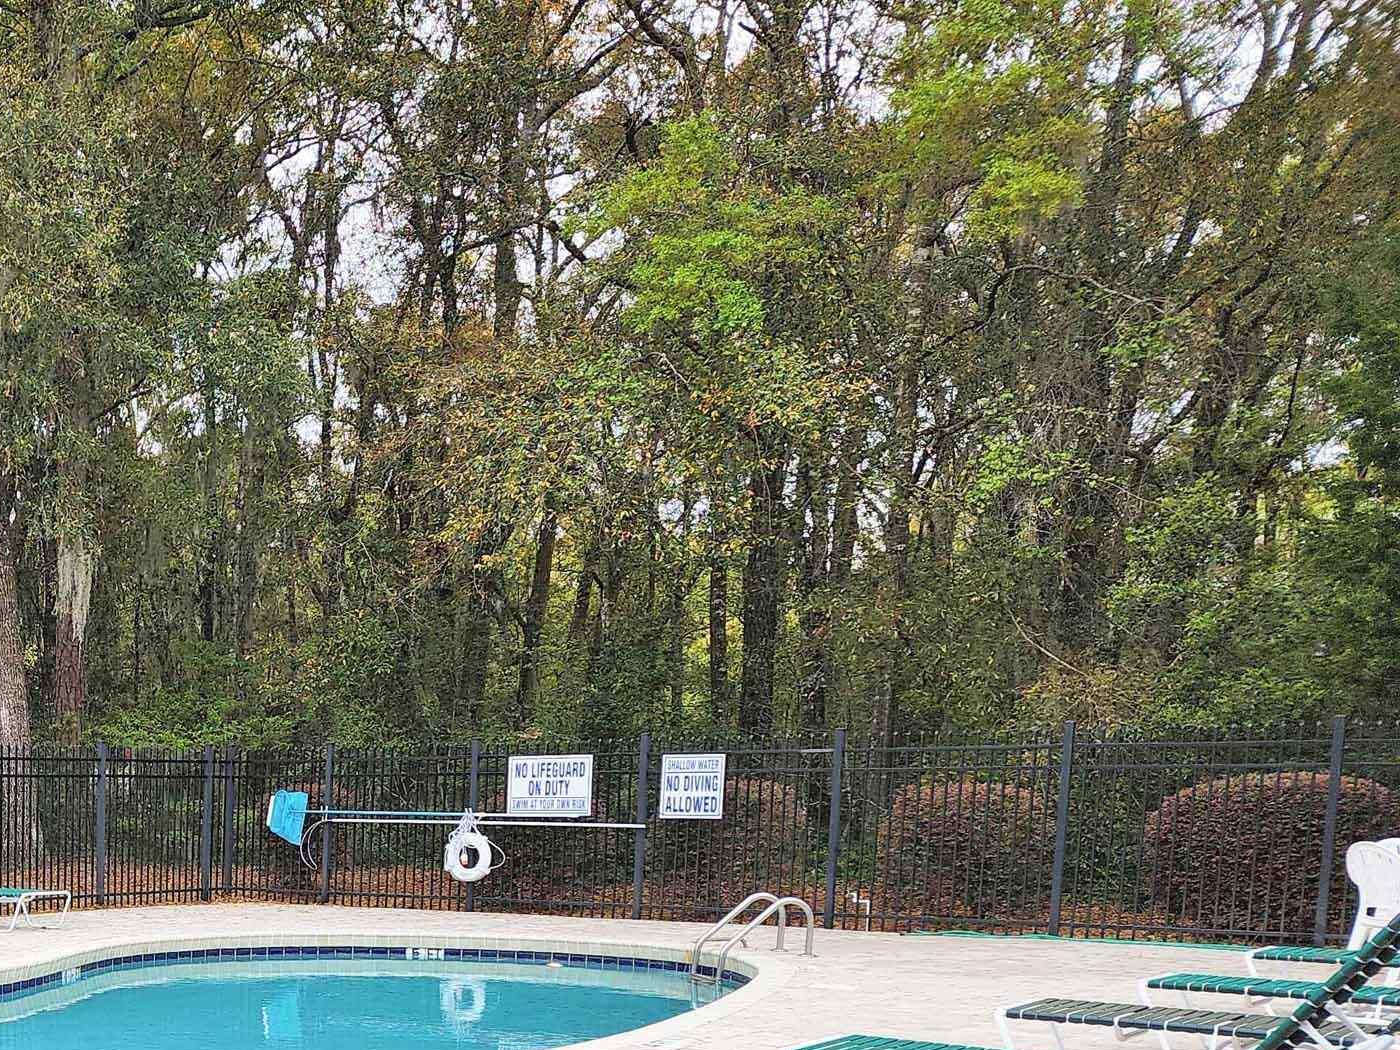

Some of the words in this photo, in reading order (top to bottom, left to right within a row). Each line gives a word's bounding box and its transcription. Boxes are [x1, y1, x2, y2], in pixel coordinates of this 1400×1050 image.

[515, 762, 529, 778] NO
[531, 761, 586, 778] LIFEGUARD
[667, 759, 697, 770] SHALLOW
[698, 759, 719, 769] WATER
[528, 780, 542, 796] ON
[545, 780, 570, 796] DUTY
[666, 775, 680, 792] NO
[683, 775, 719, 792] DIVING
[665, 796, 718, 813] ALLOWED
